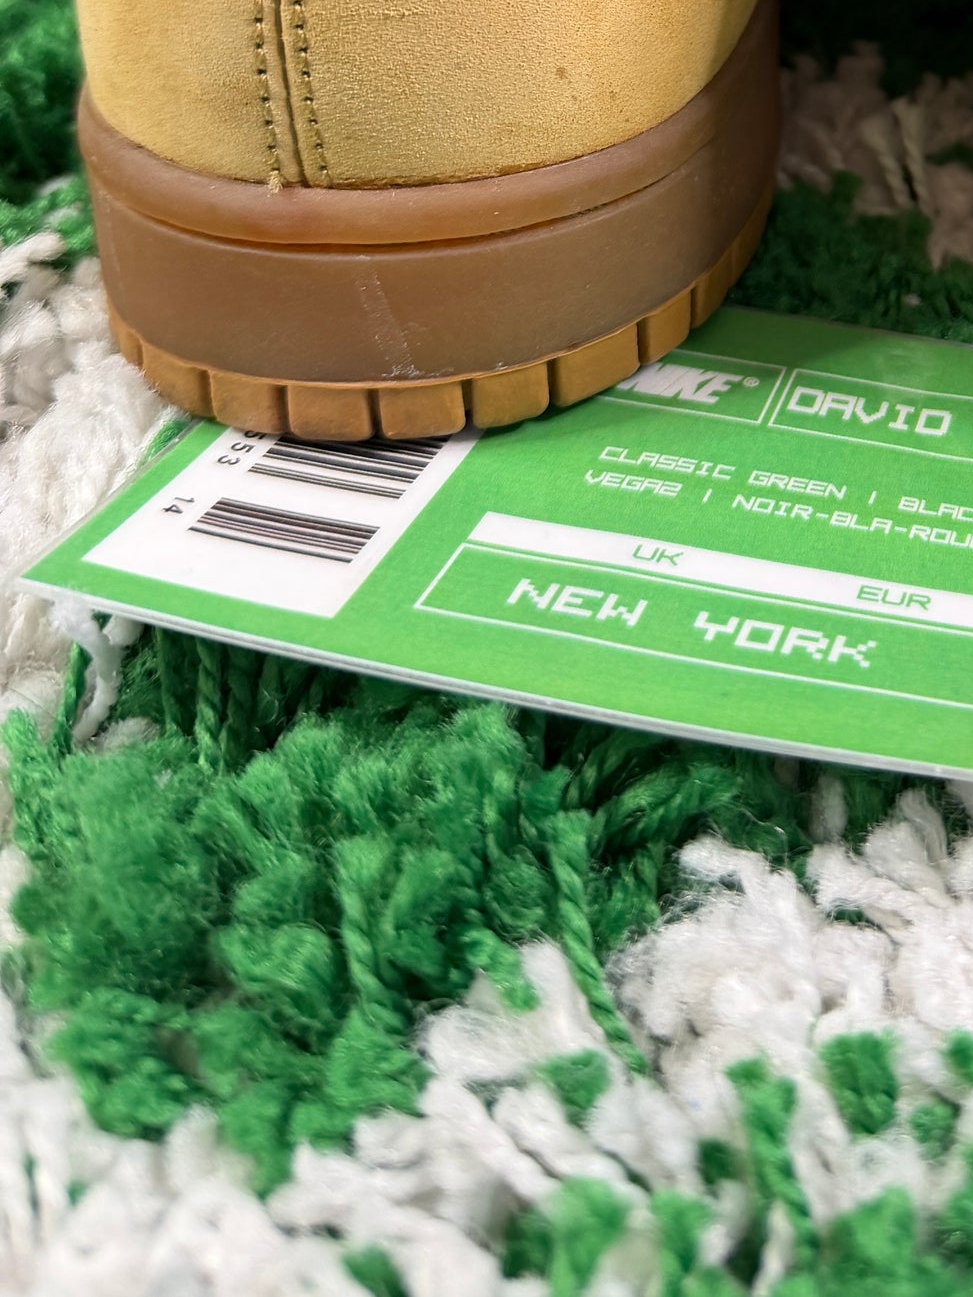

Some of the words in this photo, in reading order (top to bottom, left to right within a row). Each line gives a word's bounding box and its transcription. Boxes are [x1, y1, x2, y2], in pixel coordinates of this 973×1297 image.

[787, 385, 953, 437] DAVID
[599, 446, 736, 480] CLASSIC
[747, 470, 848, 500] GREEN
[632, 543, 685, 569] UK
[506, 578, 648, 628] NEW
[693, 610, 878, 669] YORK
[856, 585, 932, 611] EUR
